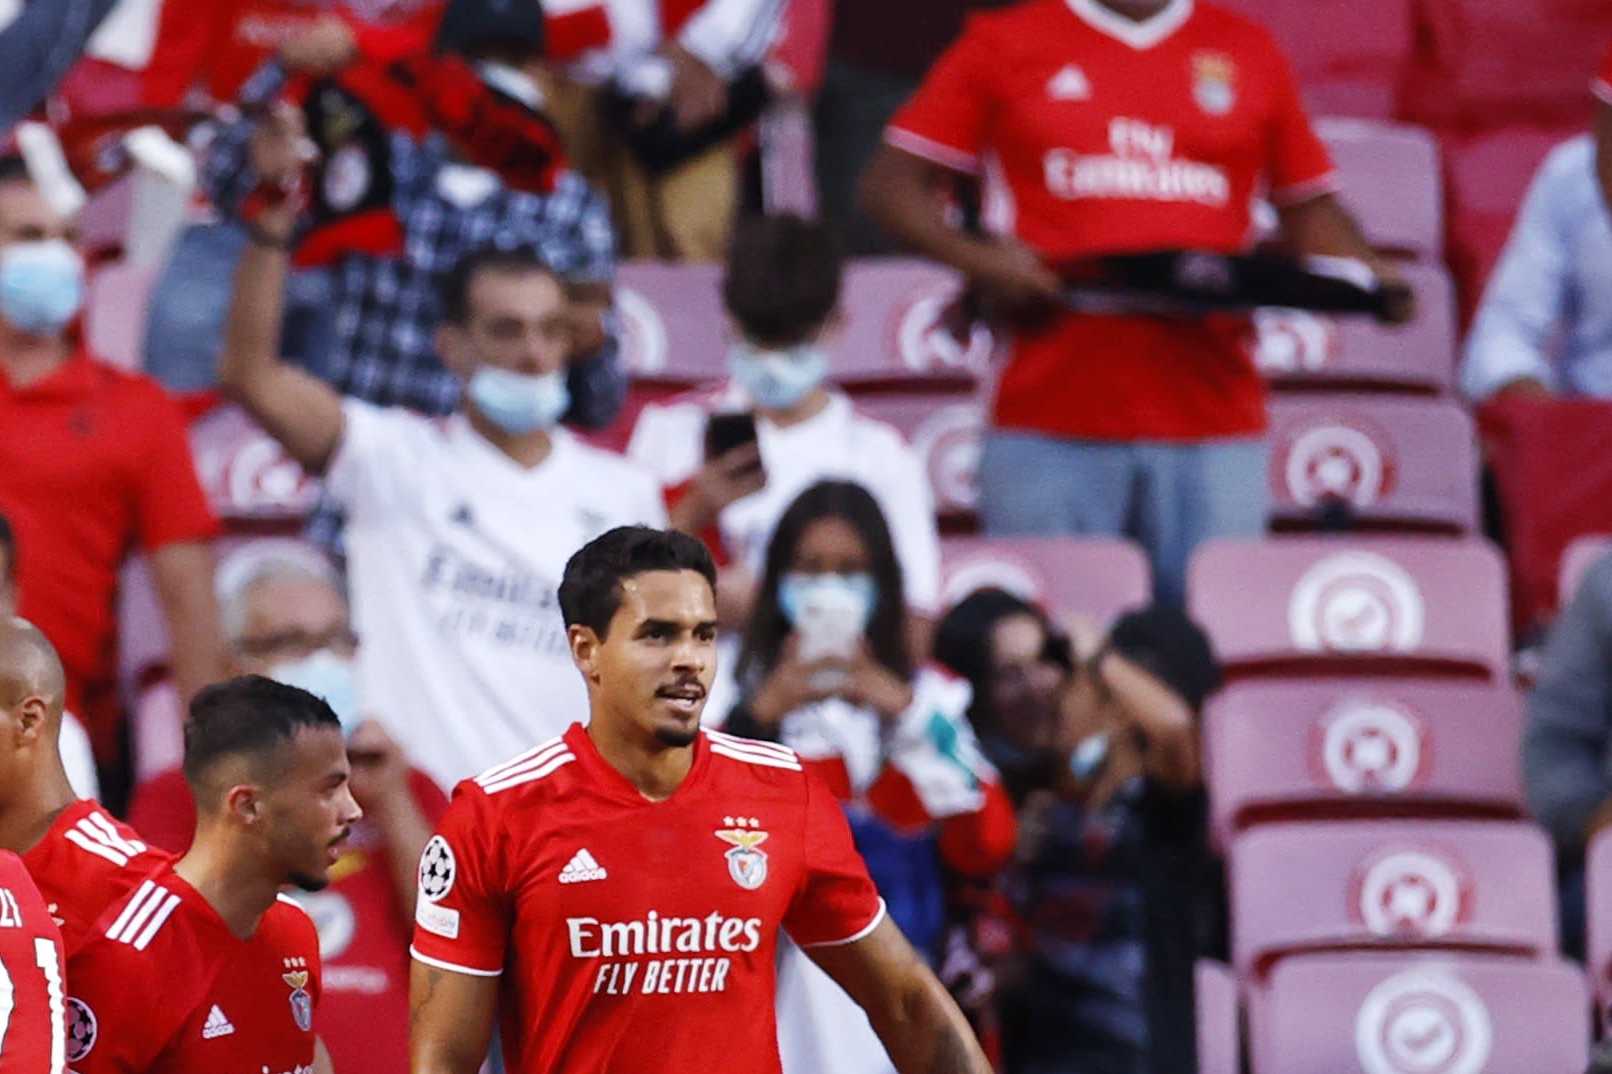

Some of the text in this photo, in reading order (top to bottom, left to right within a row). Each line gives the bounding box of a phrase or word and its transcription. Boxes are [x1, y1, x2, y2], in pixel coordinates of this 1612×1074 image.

[558, 867, 608, 884] adidas
[565, 910, 762, 958] Emirates
[592, 957, 731, 995] FLY BETTER
